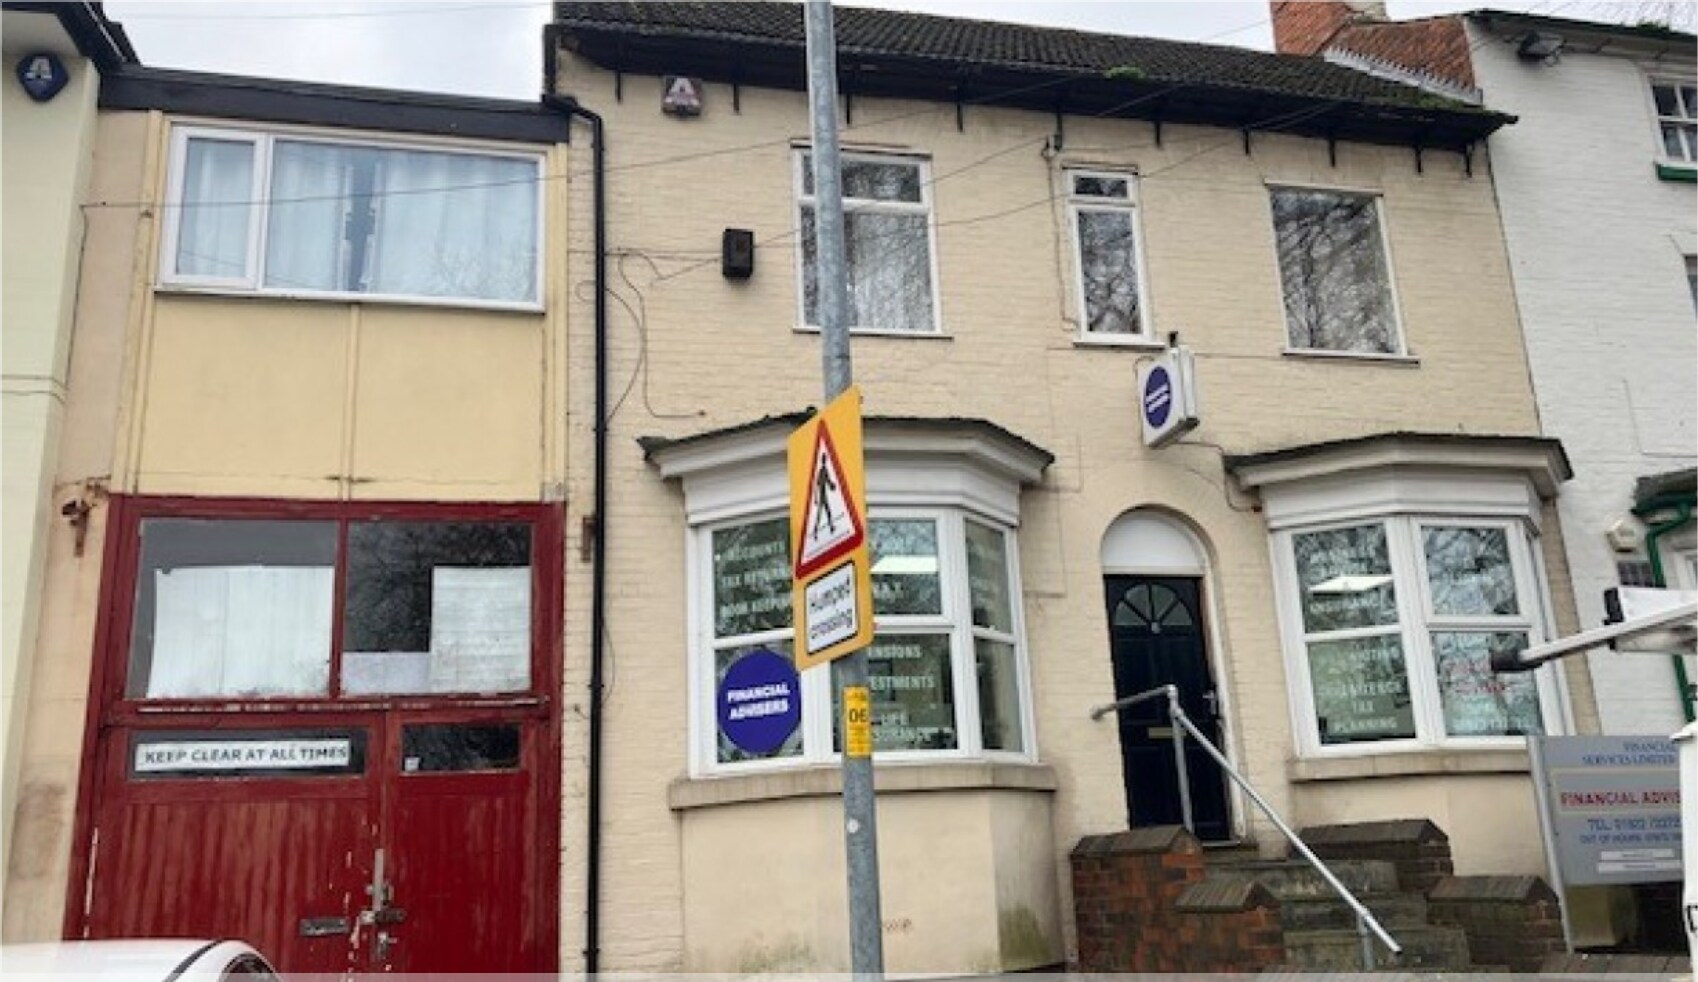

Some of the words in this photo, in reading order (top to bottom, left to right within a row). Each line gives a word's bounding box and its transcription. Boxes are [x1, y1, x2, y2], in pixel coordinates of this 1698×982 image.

[811, 608, 854, 639] crossing
[867, 644, 922, 659] ENSIONS
[869, 675, 934, 690] ESTMENTS
[727, 682, 791, 703] FINANCIAL
[729, 699, 789, 720] ADVISERS
[145, 750, 188, 764] KEEP
[191, 748, 240, 762] CLEAR
[245, 748, 266, 760] AT
[269, 746, 296, 760] ALL
[299, 745, 348, 760] TIMES
[1622, 742, 1677, 753] FINANCIAL
[1560, 790, 1639, 806] FINANCIAL
[1642, 789, 1681, 804] ADVIS
